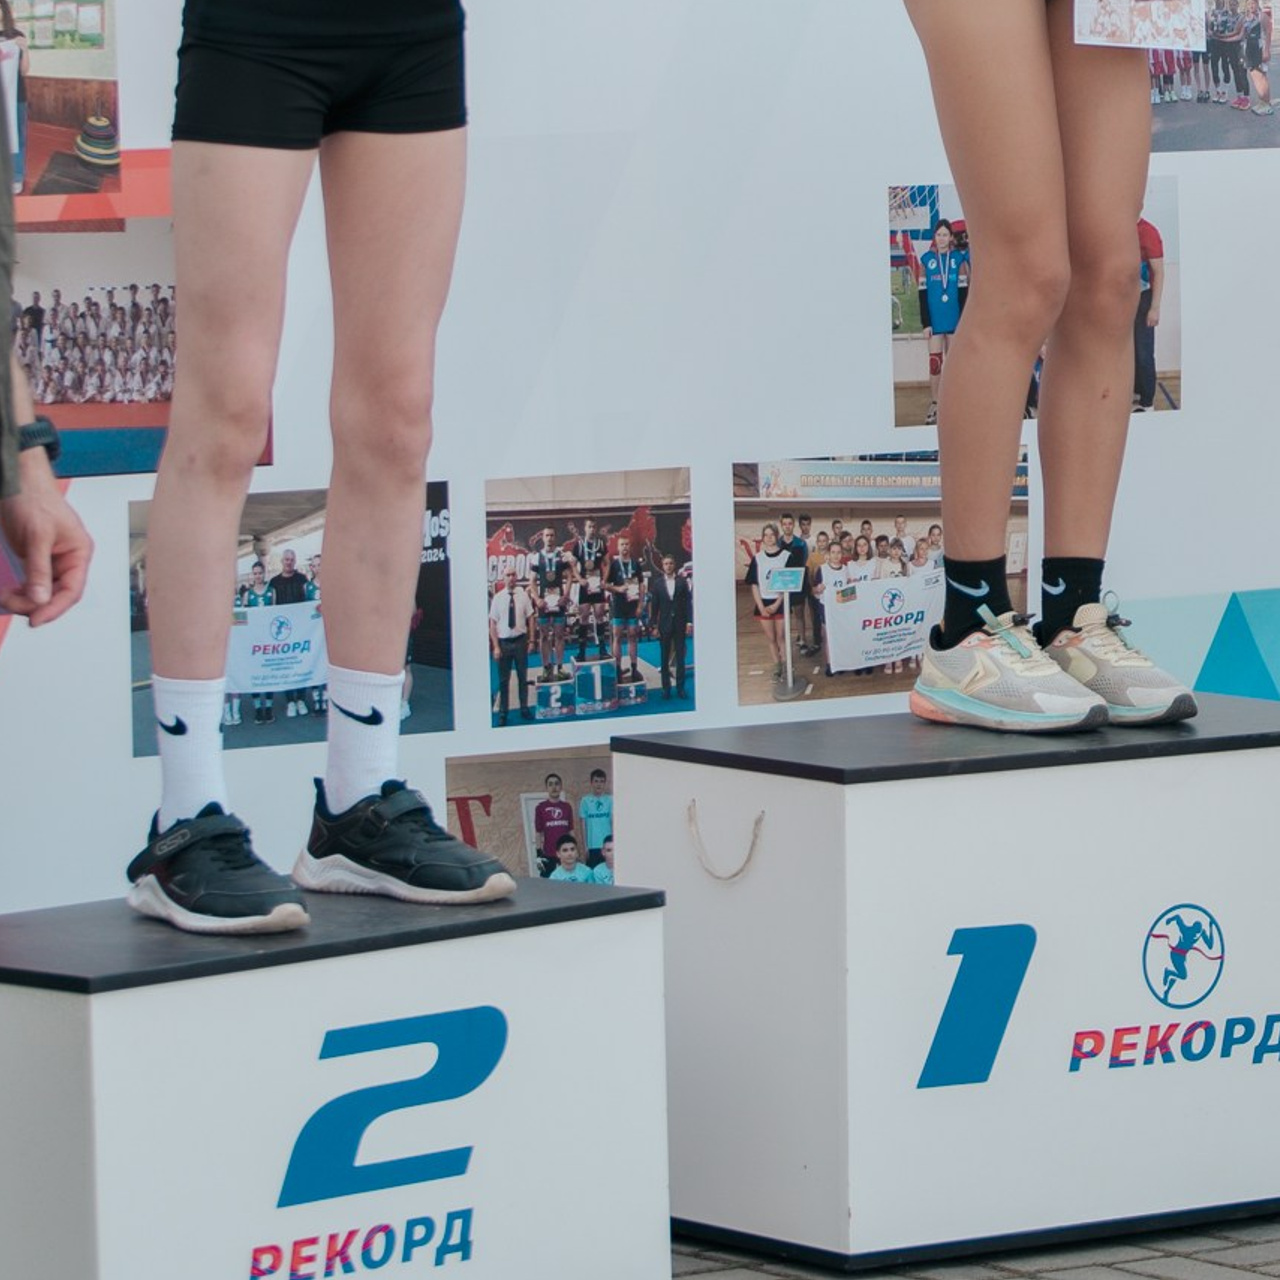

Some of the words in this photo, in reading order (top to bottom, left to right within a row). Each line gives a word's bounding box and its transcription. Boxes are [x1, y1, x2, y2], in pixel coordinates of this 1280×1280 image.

[421, 548, 445, 563] 2024
[862, 610, 925, 630] РЕКОРД
[251, 640, 311, 655] РЕКОРД
[916, 923, 1037, 1089] 1
[276, 1005, 509, 1208] 2
[248, 1207, 474, 1280] РЕКОРД
